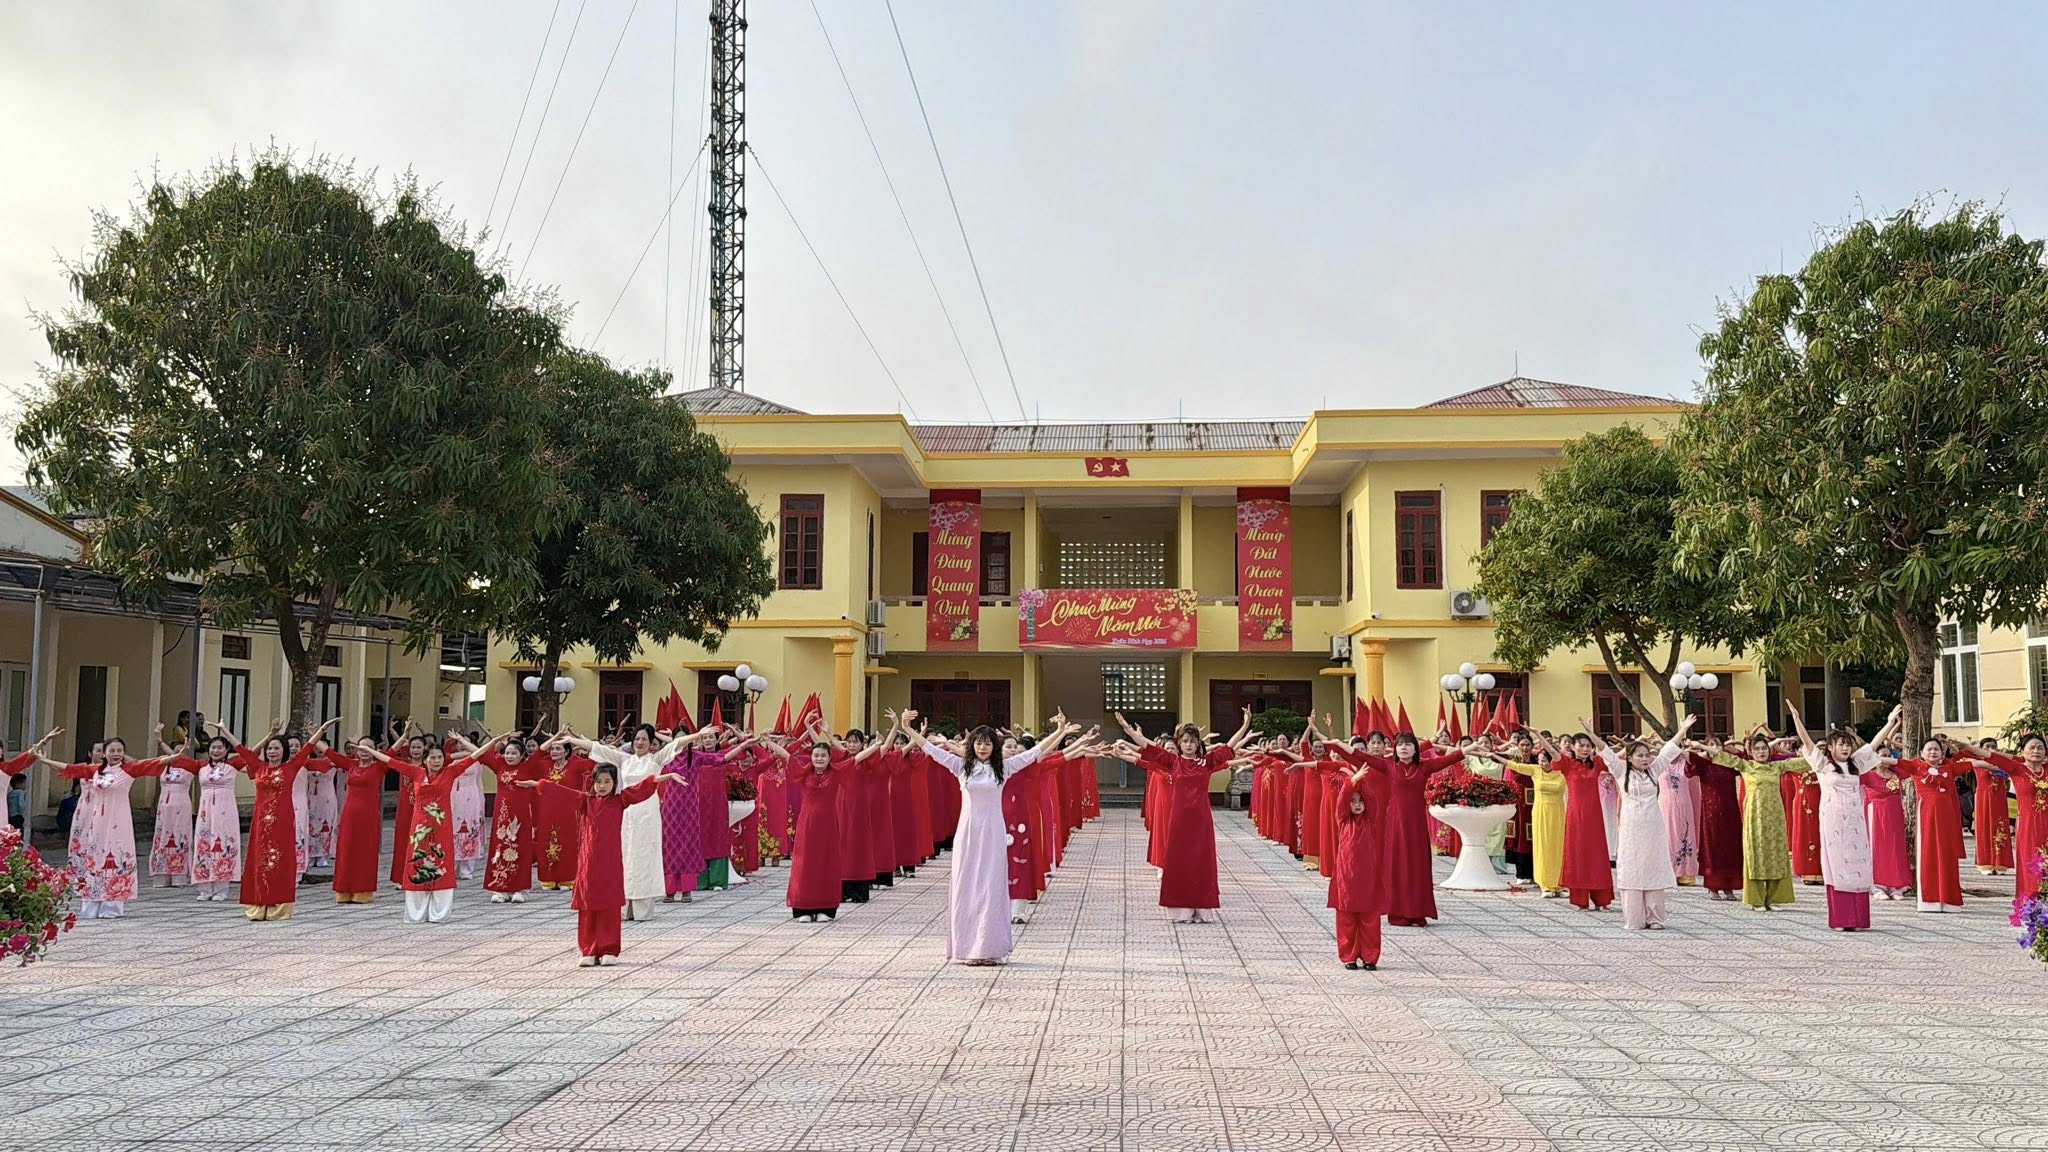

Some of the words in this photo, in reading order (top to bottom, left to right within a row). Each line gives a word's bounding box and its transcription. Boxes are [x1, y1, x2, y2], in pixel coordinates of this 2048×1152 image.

[934, 553, 973, 572] Đảng
[1250, 547, 1278, 560] Đất
[1244, 565, 1283, 578] Nước
[931, 575, 974, 594] Quang
[1243, 583, 1284, 597] Vươn
[934, 599, 970, 616] Vinh
[1038, 599, 1103, 627] Chúc
[1097, 595, 1137, 615] Mừng
[1095, 616, 1142, 637] Năm
[1134, 616, 1170, 632] Mới
